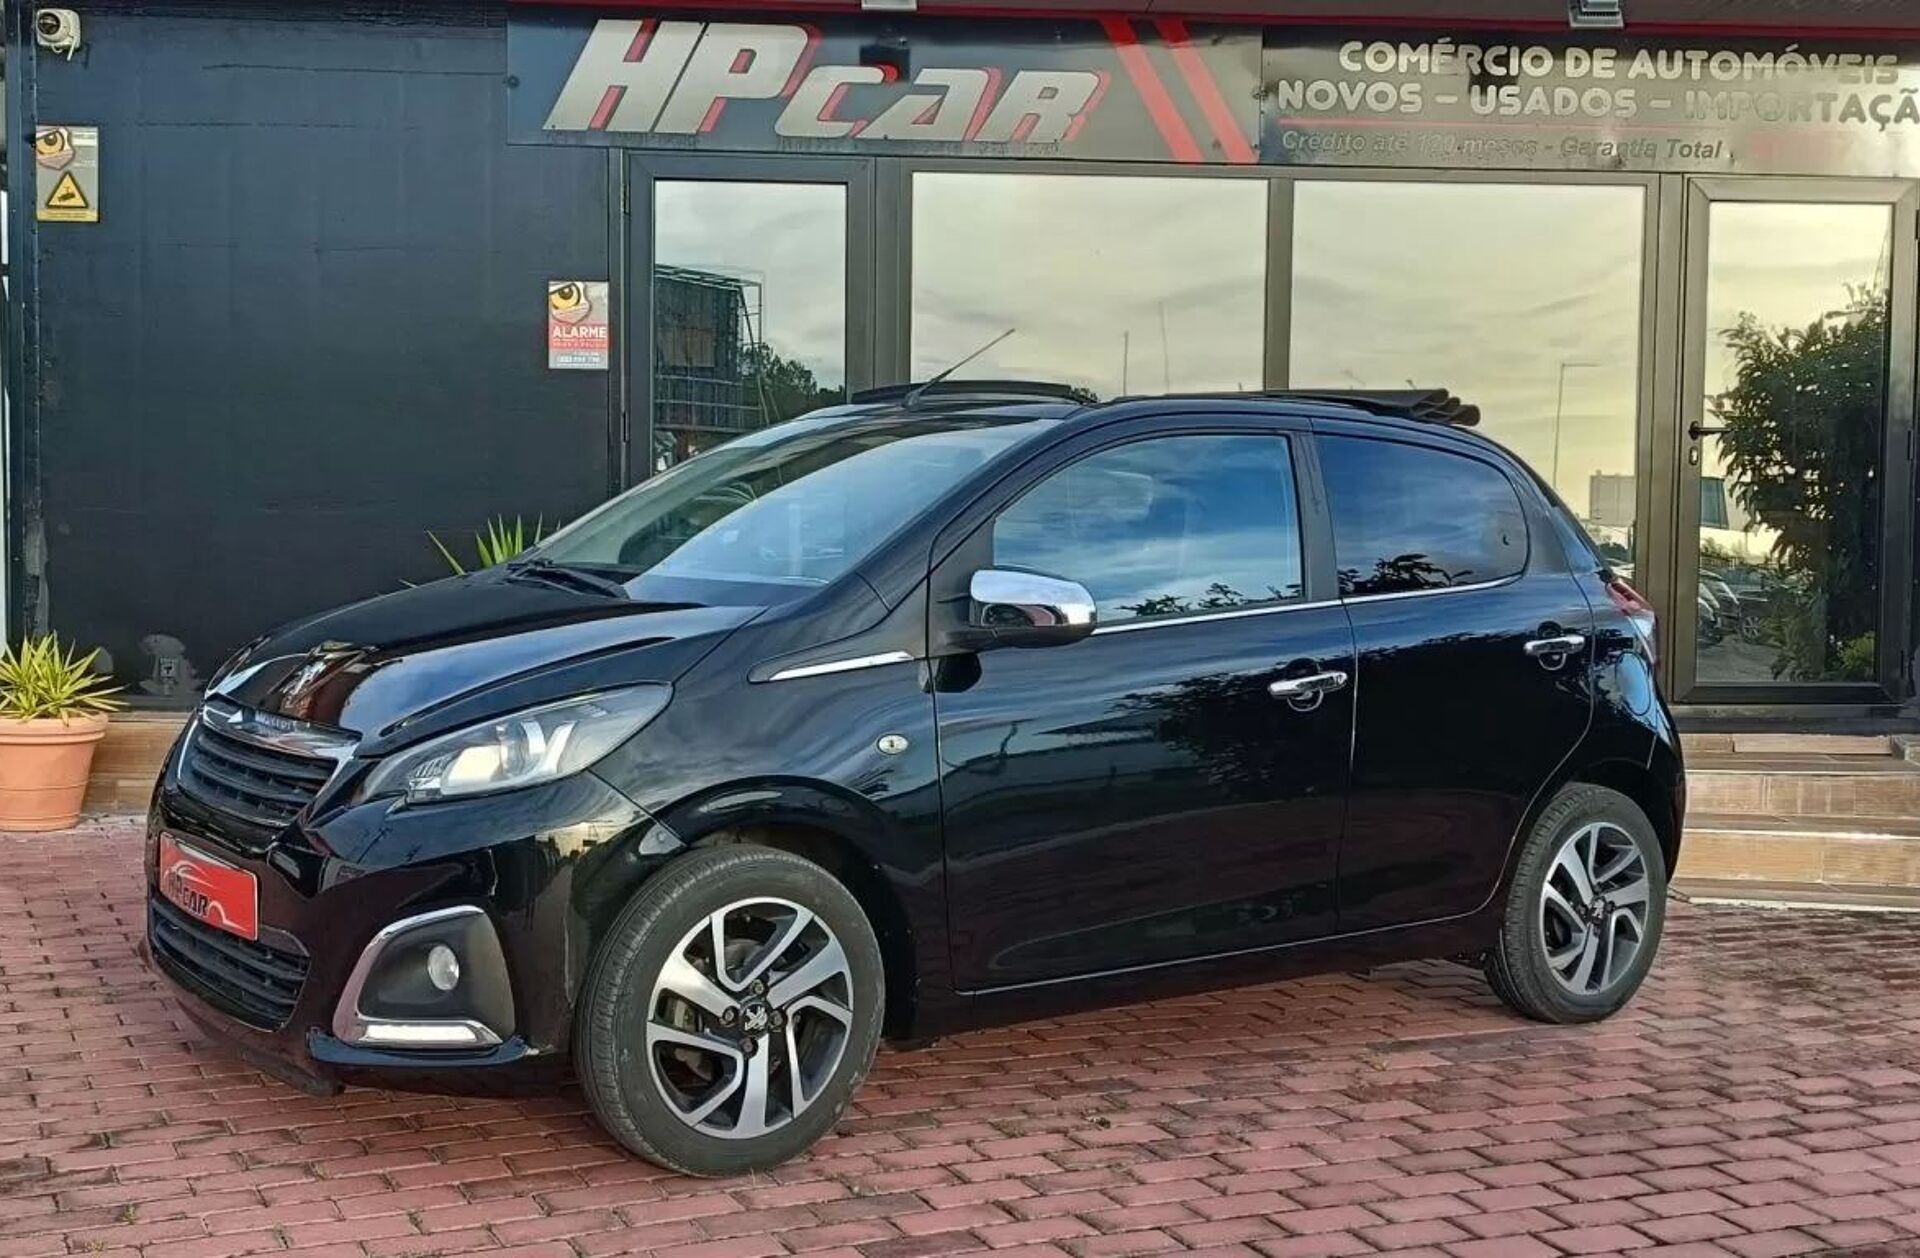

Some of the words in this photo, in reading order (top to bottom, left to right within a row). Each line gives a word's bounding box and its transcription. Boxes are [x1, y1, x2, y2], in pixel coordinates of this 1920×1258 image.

[1338, 37, 1554, 78] COMÉRCIO
[1565, 47, 1617, 79] DE
[1627, 43, 1899, 85] AUTOMÓVEIS
[1277, 79, 1423, 113] NOVOS
[1469, 84, 1638, 118] USADOS
[1666, 138, 1723, 160] Total
[552, 325, 608, 338] ALARME
